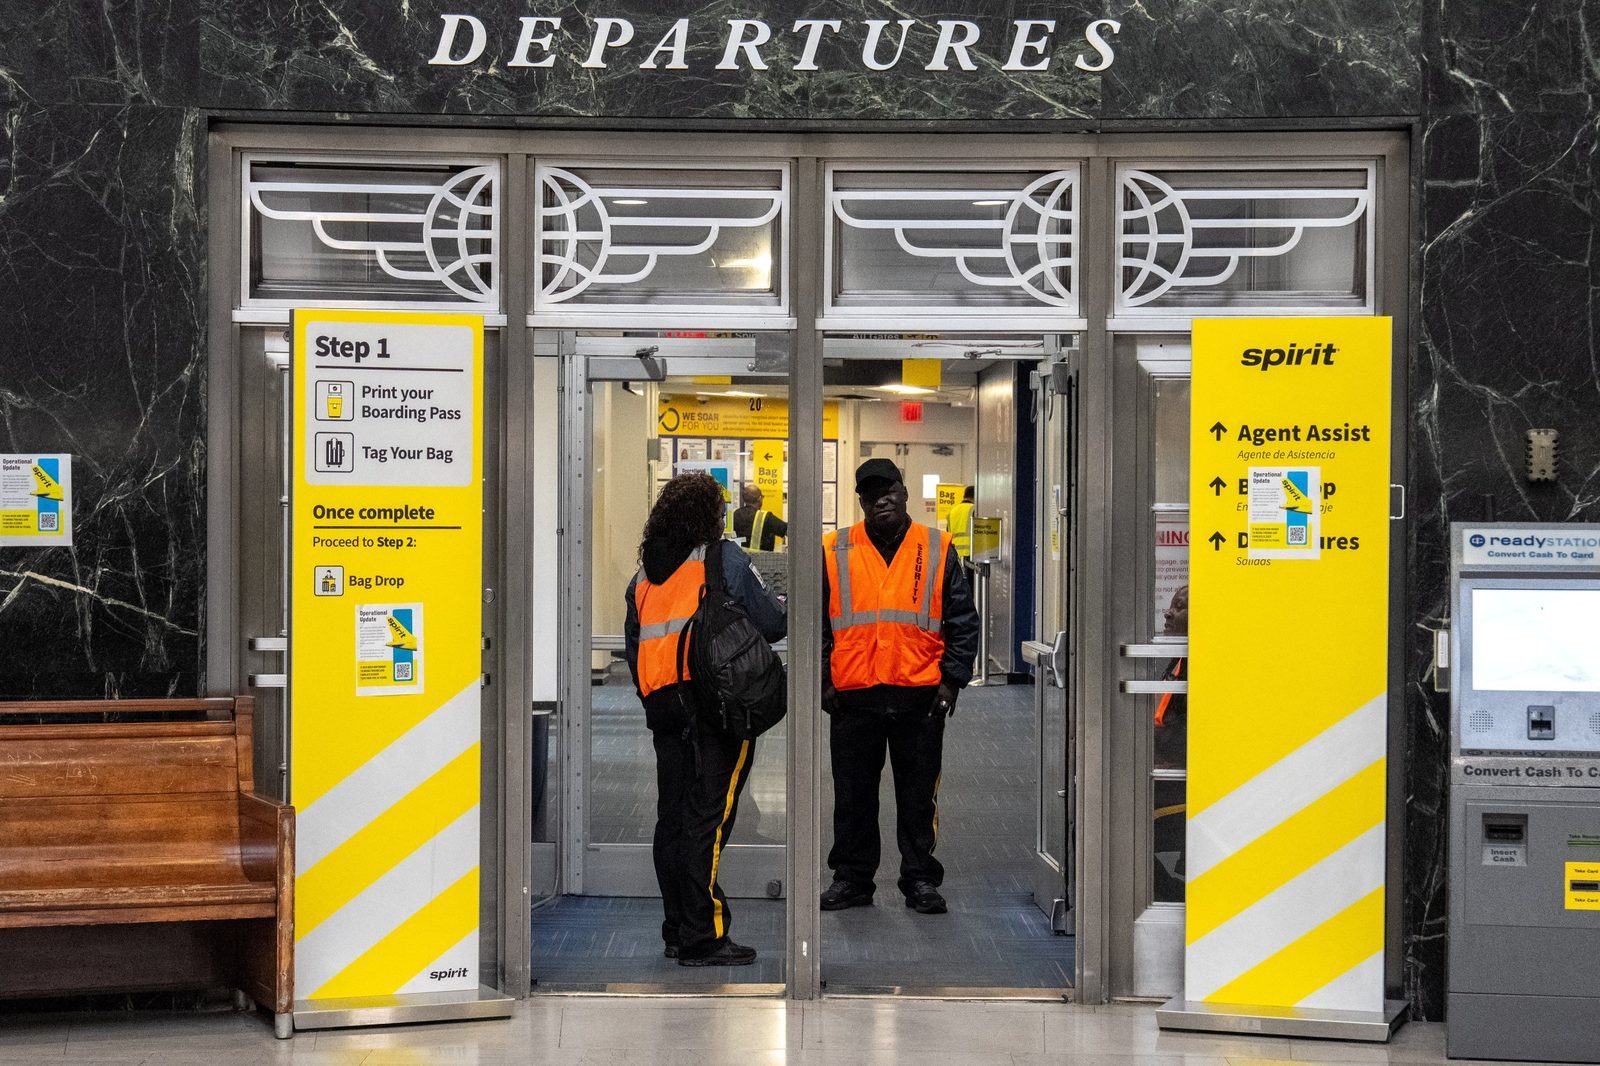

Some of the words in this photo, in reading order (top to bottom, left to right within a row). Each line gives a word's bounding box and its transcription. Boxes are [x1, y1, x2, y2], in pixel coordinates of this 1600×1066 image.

[427, 13, 1122, 73] DEPARTURES
[315, 335, 370, 363] Step
[377, 338, 390, 358] 1
[1240, 343, 1336, 371] spirit
[361, 385, 398, 399] Print
[400, 388, 434, 402] your
[750, 398, 762, 411] 20
[361, 405, 427, 422] Boarding
[429, 407, 462, 420] Pass
[682, 412, 696, 421] WE
[697, 412, 719, 421] SOAR
[702, 423, 719, 431] YOU
[1237, 424, 1301, 446] Agent
[1306, 423, 1371, 442] Assist
[361, 446, 388, 462] Tag
[390, 446, 424, 460] Your
[426, 447, 454, 463] Bag
[1237, 450, 1271, 461] Agente
[1273, 450, 1286, 459] de
[1287, 450, 1336, 460] Asistencia
[32, 466, 52, 488] spirit
[758, 467, 778, 478] Bag
[758, 478, 778, 486] Drop
[939, 490, 955, 499] Bag
[1281, 479, 1301, 502] spirit
[312, 504, 355, 520] Once
[358, 504, 435, 523] complete
[312, 536, 360, 548] Proceed
[362, 537, 375, 548] to
[376, 537, 404, 549] Step
[406, 537, 417, 548] 2:
[1490, 535, 1600, 548] readySTATIO
[1487, 550, 1526, 558] Convert
[1570, 551, 1594, 559] Card
[912, 542, 923, 604] SECURITY
[349, 575, 373, 589] Bag
[375, 576, 405, 589] Drop
[387, 617, 406, 639] spirit
[1463, 765, 1521, 776] Convert
[1525, 766, 1562, 777] Cash
[1566, 767, 1583, 777] To
[429, 967, 468, 981] spirit
